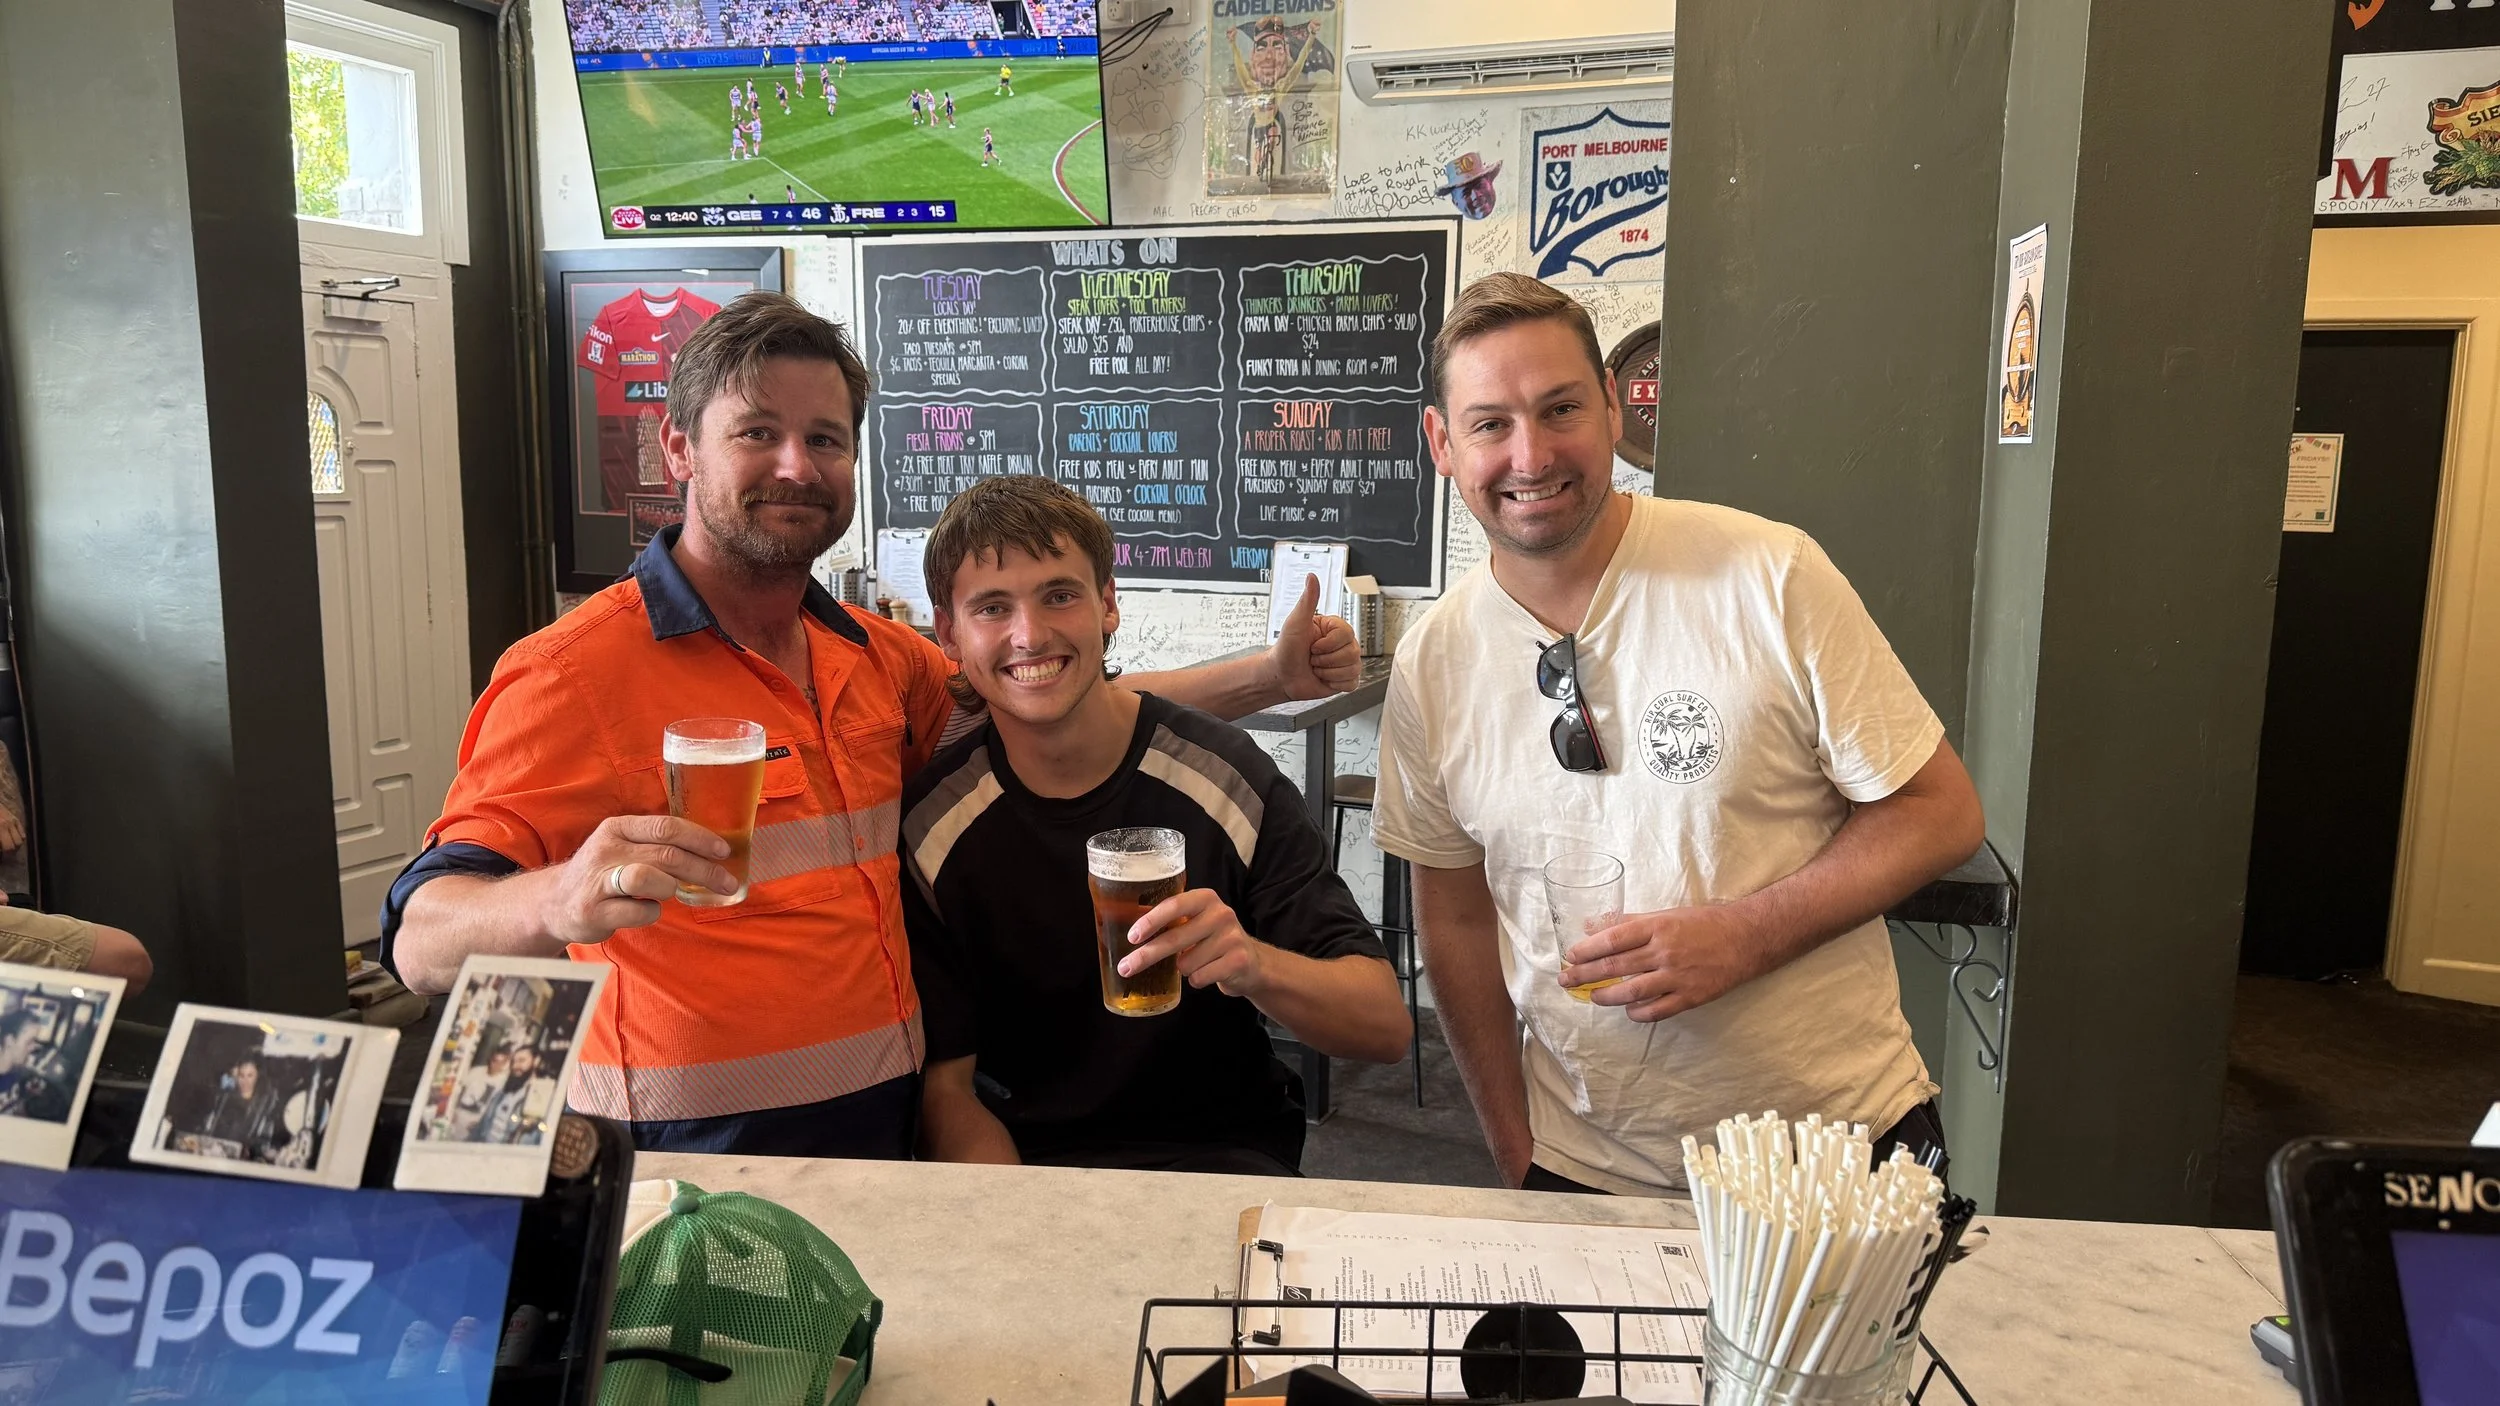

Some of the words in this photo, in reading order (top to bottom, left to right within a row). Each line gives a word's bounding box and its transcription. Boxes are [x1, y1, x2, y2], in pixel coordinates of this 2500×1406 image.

[1213, 0, 1271, 17] CADEL
[1273, 0, 1336, 14] EVANS
[1542, 144, 1577, 159] PORT
[1584, 138, 1668, 157] MELBOURNE
[1344, 173, 1372, 188] Love
[1378, 166, 1392, 177] to
[1395, 156, 1431, 174] drink
[614, 216, 642, 224] LIVE
[665, 212, 698, 222] 12:40
[726, 210, 762, 221] GEE
[772, 211, 778, 219] 7
[786, 210, 793, 218] 4
[802, 208, 822, 220] 46
[851, 208, 886, 219] FRE
[898, 208, 904, 217] 2
[911, 208, 918, 216] 3
[928, 205, 946, 218] 15
[1153, 206, 1174, 218] MAC
[1619, 228, 1649, 244] 1874
[1051, 239, 1125, 266] WHATS
[1139, 236, 1178, 264] ON
[922, 274, 982, 300] TUESDAY
[1080, 271, 1172, 298] WEDNESDAY
[1282, 263, 1364, 296] THURSDAY
[933, 301, 960, 316] LOCALS
[1068, 299, 1091, 316] STEAK
[1093, 298, 1120, 316] LOVERS
[1129, 298, 1146, 315] POOL
[1152, 297, 1186, 314] PLAYERS!
[1244, 297, 1282, 314] THINKERS
[1286, 296, 1326, 314] DRINKERS
[1335, 295, 1360, 314] PARMA
[1362, 293, 1399, 312] LOVERS!
[916, 318, 931, 334] OFF
[934, 316, 982, 334] EVERYTHING!
[1058, 316, 1083, 334] STEAK
[1085, 316, 1101, 334] DAY
[1183, 315, 1206, 333] CHIPS
[1244, 316, 1271, 333] PARMA
[1274, 314, 1289, 333] DAY
[1296, 314, 1332, 333] CHICKEN
[1362, 314, 1386, 332] CHIPS
[1394, 313, 1417, 332] SALAD
[903, 342, 920, 355] TACO
[924, 341, 955, 356] TUESDAYS
[1062, 336, 1088, 354] SALAD
[1092, 333, 1109, 356] $25
[1116, 335, 1134, 354] AND
[1302, 332, 1320, 354] $24
[621, 354, 656, 363] MARATHON
[903, 357, 922, 372] TACOS
[958, 356, 995, 371] MARGARITA
[1002, 356, 1028, 370] CORONA
[1089, 356, 1110, 376] FREE
[1112, 356, 1130, 374] POOL
[1135, 356, 1150, 374] ALL
[1152, 356, 1170, 374] DAY!
[1246, 358, 1272, 377] FUNKY
[1276, 358, 1298, 376] TRIVIA
[1302, 358, 1311, 376] IN
[1315, 358, 1341, 376] DINING
[1345, 358, 1368, 376] ROOM
[1380, 356, 1398, 375] 7PM
[931, 372, 961, 386] SPECIALS
[1632, 384, 1656, 399] EX
[922, 406, 974, 430] FRIDAY
[1080, 404, 1150, 430] SATURDAY
[1273, 401, 1334, 429] SUNDAY
[906, 433, 930, 452] FIESTA
[935, 431, 964, 452] FRIDAYS
[966, 436, 976, 446] @
[979, 430, 996, 451] 5PM
[1068, 433, 1102, 452] PARENTS
[1110, 432, 1144, 452] COCKTAIL
[1244, 431, 1250, 450] A
[1254, 430, 1287, 452] PROPER
[1290, 430, 1315, 451] ROAST
[1324, 428, 1344, 451] KIDS
[1347, 428, 1363, 450] EAT
[1368, 427, 1392, 450] FREE!
[916, 455, 935, 474] FREE
[937, 455, 956, 474] MEAT
[959, 455, 976, 474] TRAY
[978, 454, 1003, 474] RAFFLE
[1007, 454, 1033, 474] DRAWN
[1059, 459, 1080, 480] FREE
[1084, 459, 1102, 480] KIDS
[1106, 460, 1126, 480] MEAL
[1138, 459, 1158, 480] EVERY
[1162, 459, 1184, 480] ADULT
[1191, 458, 1209, 482] MAIN
[1240, 458, 1258, 478] FREE
[1260, 460, 1277, 478] KIDS
[1280, 459, 1298, 478] MEAL
[1310, 458, 1334, 480] EVERY
[1340, 458, 1364, 479] ADULT
[1368, 459, 1392, 480] MAIN
[1394, 460, 1416, 480] MEAL
[934, 476, 951, 494] LIVE
[1086, 484, 1122, 504] PURCHASED
[1134, 484, 1170, 505] COCKTAIL
[1244, 478, 1285, 494] PURCHASED
[1296, 478, 1328, 494] SUNDAY
[1332, 480, 1354, 494] ROAST
[910, 496, 928, 512] FREE
[1260, 506, 1277, 522] LIVE
[1280, 505, 1304, 522] MUSIC
[1320, 508, 1339, 522] 2PM
[1128, 508, 1156, 522] COCKTAIL
[1230, 546, 1268, 569] WEEKDAY
[1644, 710, 1656, 724] RIP
[1654, 695, 1674, 710] CURL
[1676, 693, 1698, 704] SURF
[1698, 702, 1708, 713] CO
[1649, 760, 1680, 780] QUALITY
[1683, 749, 1719, 780] PRODUCTS
[0, 1211, 374, 1368] Bepoz
